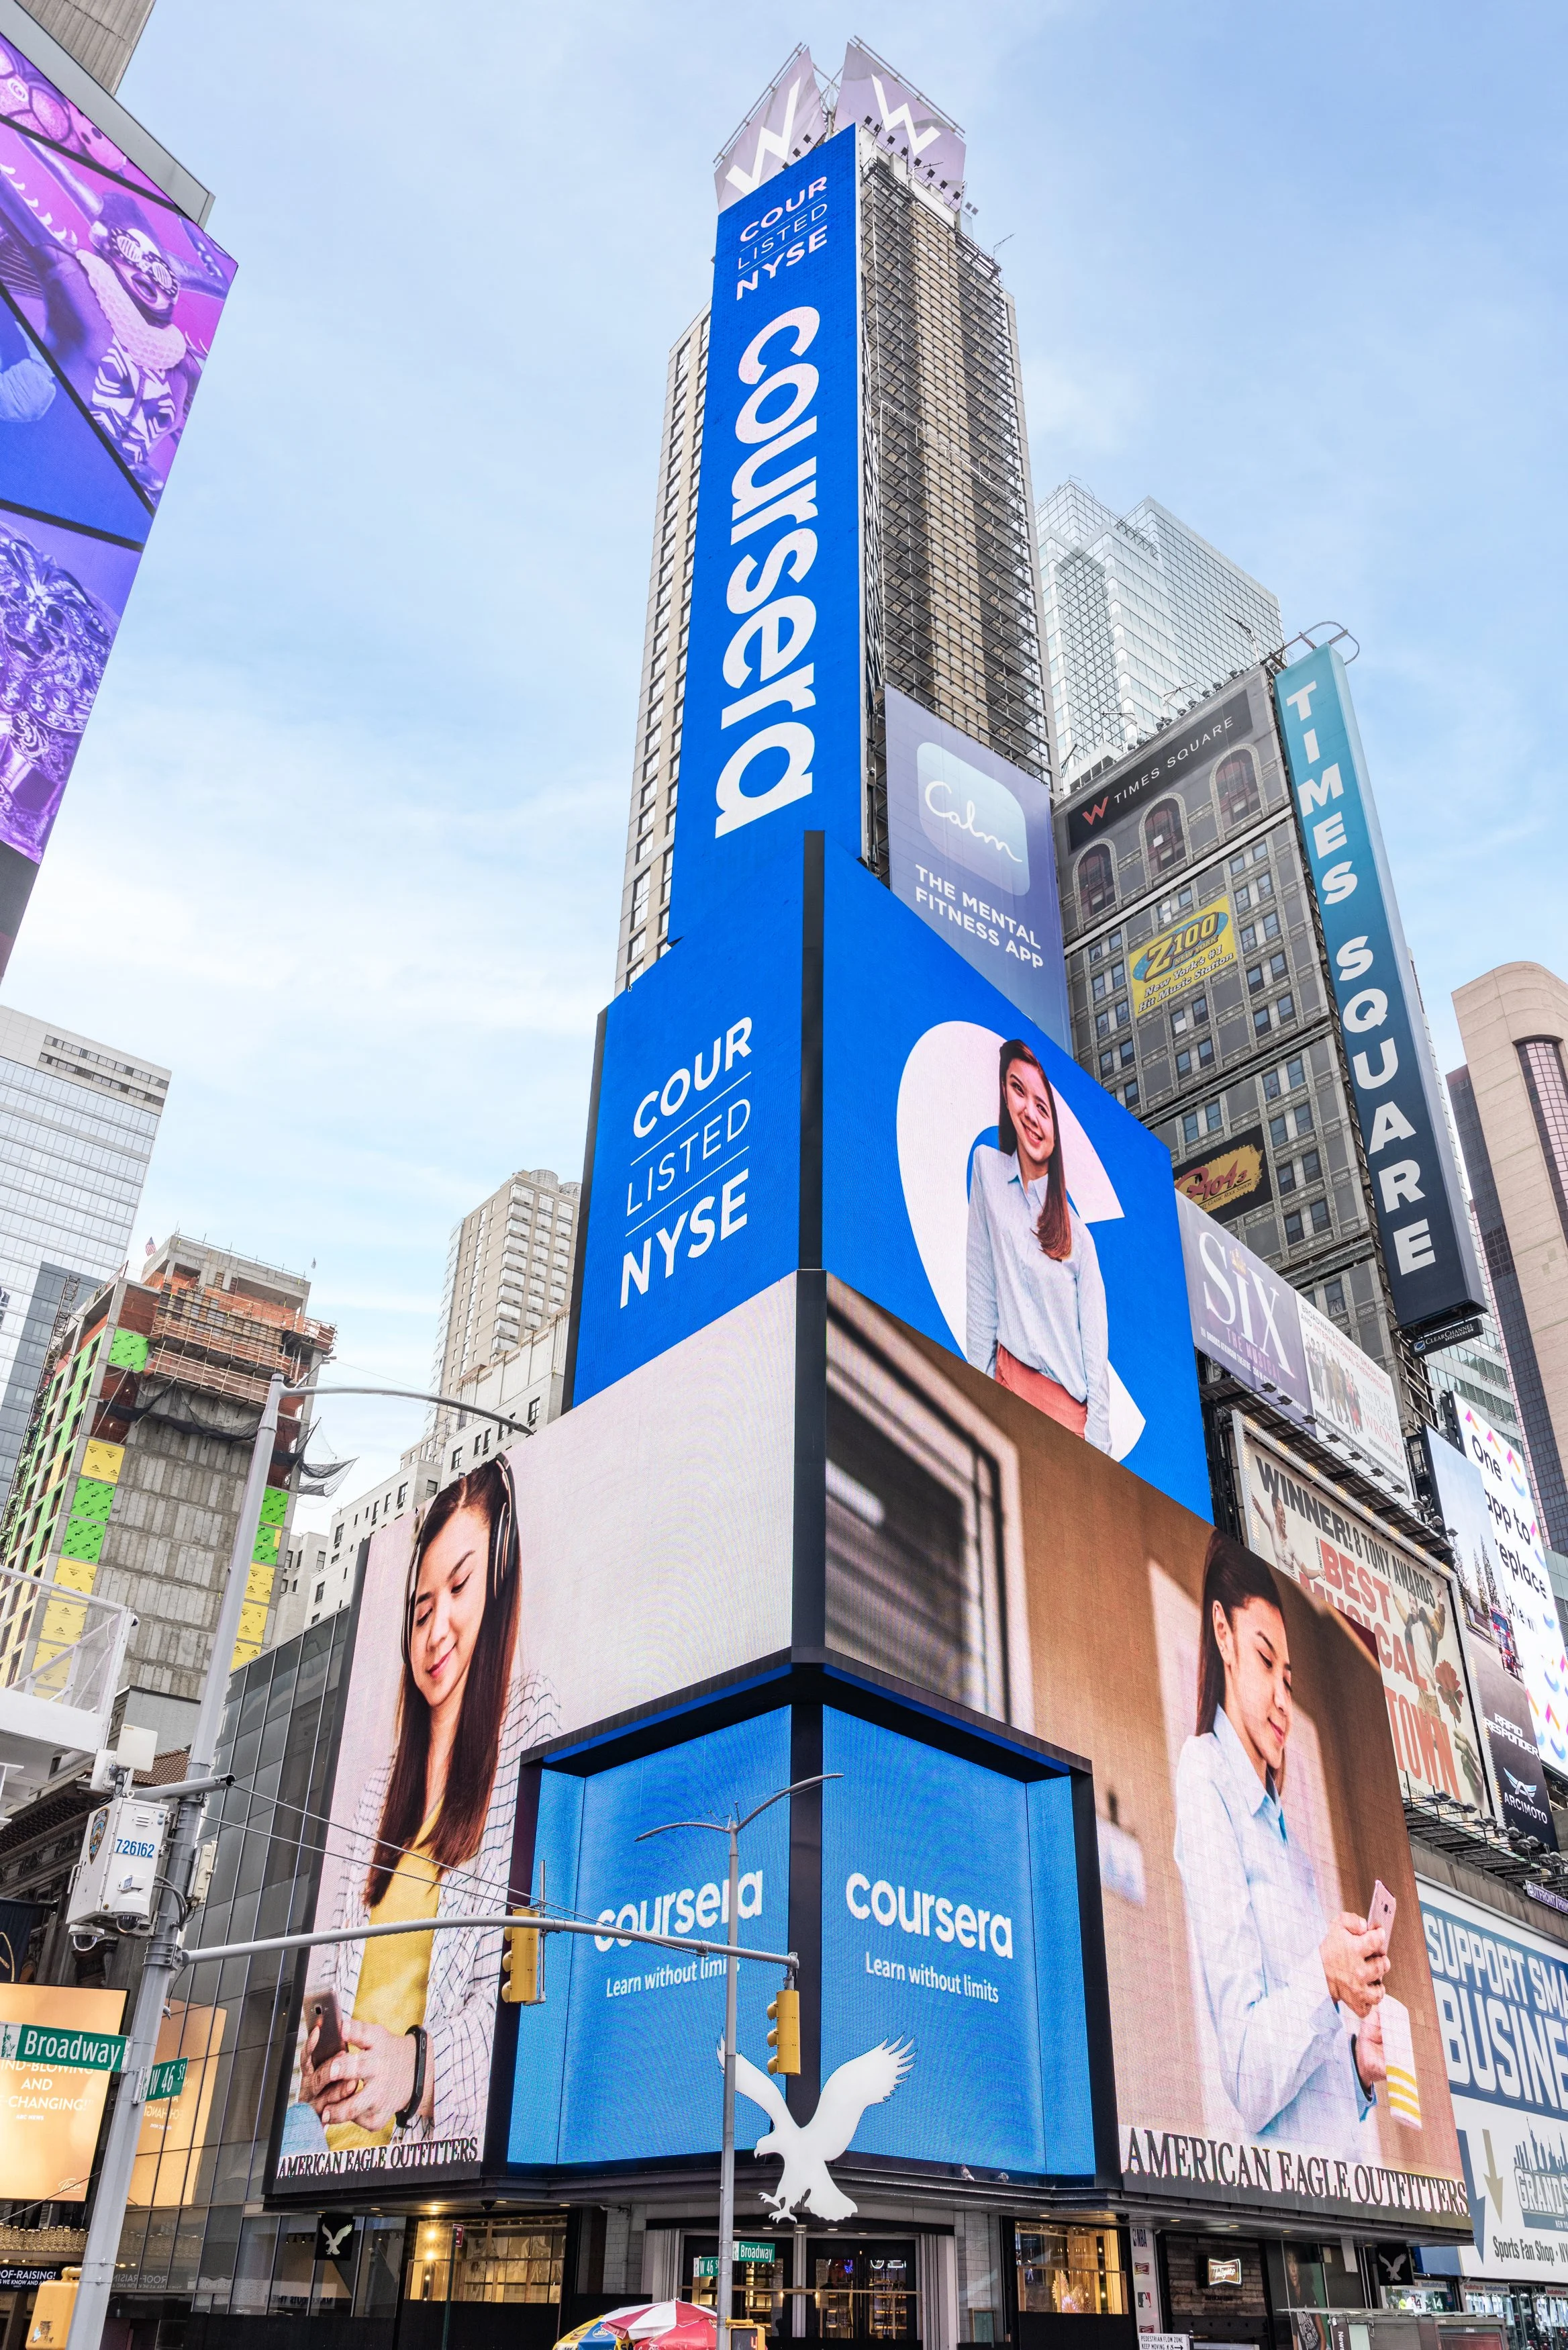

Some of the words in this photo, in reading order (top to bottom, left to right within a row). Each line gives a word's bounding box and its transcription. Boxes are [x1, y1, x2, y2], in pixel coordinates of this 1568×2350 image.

[726, 77, 801, 195] W
[871, 73, 941, 157] W
[738, 203, 828, 270] LISTED
[740, 176, 828, 242] COUR
[736, 224, 828, 301] NYSE
[715, 306, 820, 839] coursera
[1082, 796, 1109, 826] W
[1114, 767, 1161, 804] TIMES
[1167, 716, 1234, 769] SQUARE
[925, 780, 1023, 863] Calm
[915, 863, 956, 901] THE
[962, 891, 1041, 949] MENTAL
[916, 886, 1000, 947] FITNESS
[1005, 939, 1044, 969] APP
[1143, 911, 1220, 984] Z100
[1144, 977, 1171, 998] New
[1173, 956, 1206, 980] York's
[1208, 944, 1222, 961] #1
[1175, 949, 1195, 966] NEW
[1195, 935, 1219, 954] YORK
[1286, 680, 1359, 906] TIMES
[1335, 935, 1436, 1276] SQUARE
[1138, 997, 1156, 1013] Hit
[1157, 976, 1192, 1002] Music
[1193, 952, 1234, 980] Station
[633, 1017, 752, 1139] COUR
[626, 1098, 751, 1217] LISTED
[620, 1168, 749, 1309] NYSE
[1199, 1231, 1296, 1379] SIX
[1444, 1328, 1474, 1342] SPECTACOLOR
[1226, 1327, 1243, 1352] THE
[1246, 1342, 1282, 1384] MUSICAL
[1363, 1410, 1403, 1461] WRONG
[1471, 1434, 1503, 1481] One
[1255, 1454, 1354, 1553] WINNER!
[1353, 1527, 1363, 1558] 8
[1361, 1534, 1391, 1579] TONY
[1391, 1554, 1436, 1610] AWARDS
[1484, 1488, 1512, 1534] app
[1513, 1507, 1532, 1546] to
[1315, 1536, 1324, 1569] INCLUDING
[1320, 1538, 1391, 1624] BEST
[1495, 1538, 1549, 1601] eplace
[1483, 1717, 1540, 1760] RESPONDER
[1494, 1713, 1523, 1738] RAPID
[1504, 1791, 1548, 1824] ARCIMOTO
[846, 1872, 1014, 1959] coursera
[605, 1975, 642, 1998] Learn
[644, 1962, 697, 1991] without
[865, 1951, 906, 1981] Learn
[908, 1963, 961, 1995] without
[963, 1973, 999, 2004] limits
[1422, 1912, 1529, 2005] SUPPORT
[24, 2030, 121, 2071] Broadway
[1432, 1977, 1568, 2112] BUSINE
[21, 2077, 53, 2091] AND
[149, 2068, 161, 2096] W
[161, 2065, 176, 2094] 46
[177, 2063, 186, 2081] St
[58, 2177, 85, 2193] Tina
[276, 2151, 344, 2179] AMERICAN
[344, 2145, 387, 2173] EAGLE
[389, 2136, 479, 2169] OUTFITTERS
[1120, 2126, 1273, 2192] AMERICAN
[1276, 2150, 1351, 2201] EAGLE
[1354, 2163, 1471, 2217] OUTFITTERS
[699, 2260, 705, 2275] W
[706, 2260, 714, 2275] 46
[740, 2245, 773, 2263] Broadway
[1137, 2228, 1148, 2248] NBA
[1492, 2235, 1520, 2263] Sports
[1520, 2238, 1535, 2261] Fan
[1534, 2239, 1555, 2267] Shop
[0, 2269, 56, 2280] OF-RAISING!
